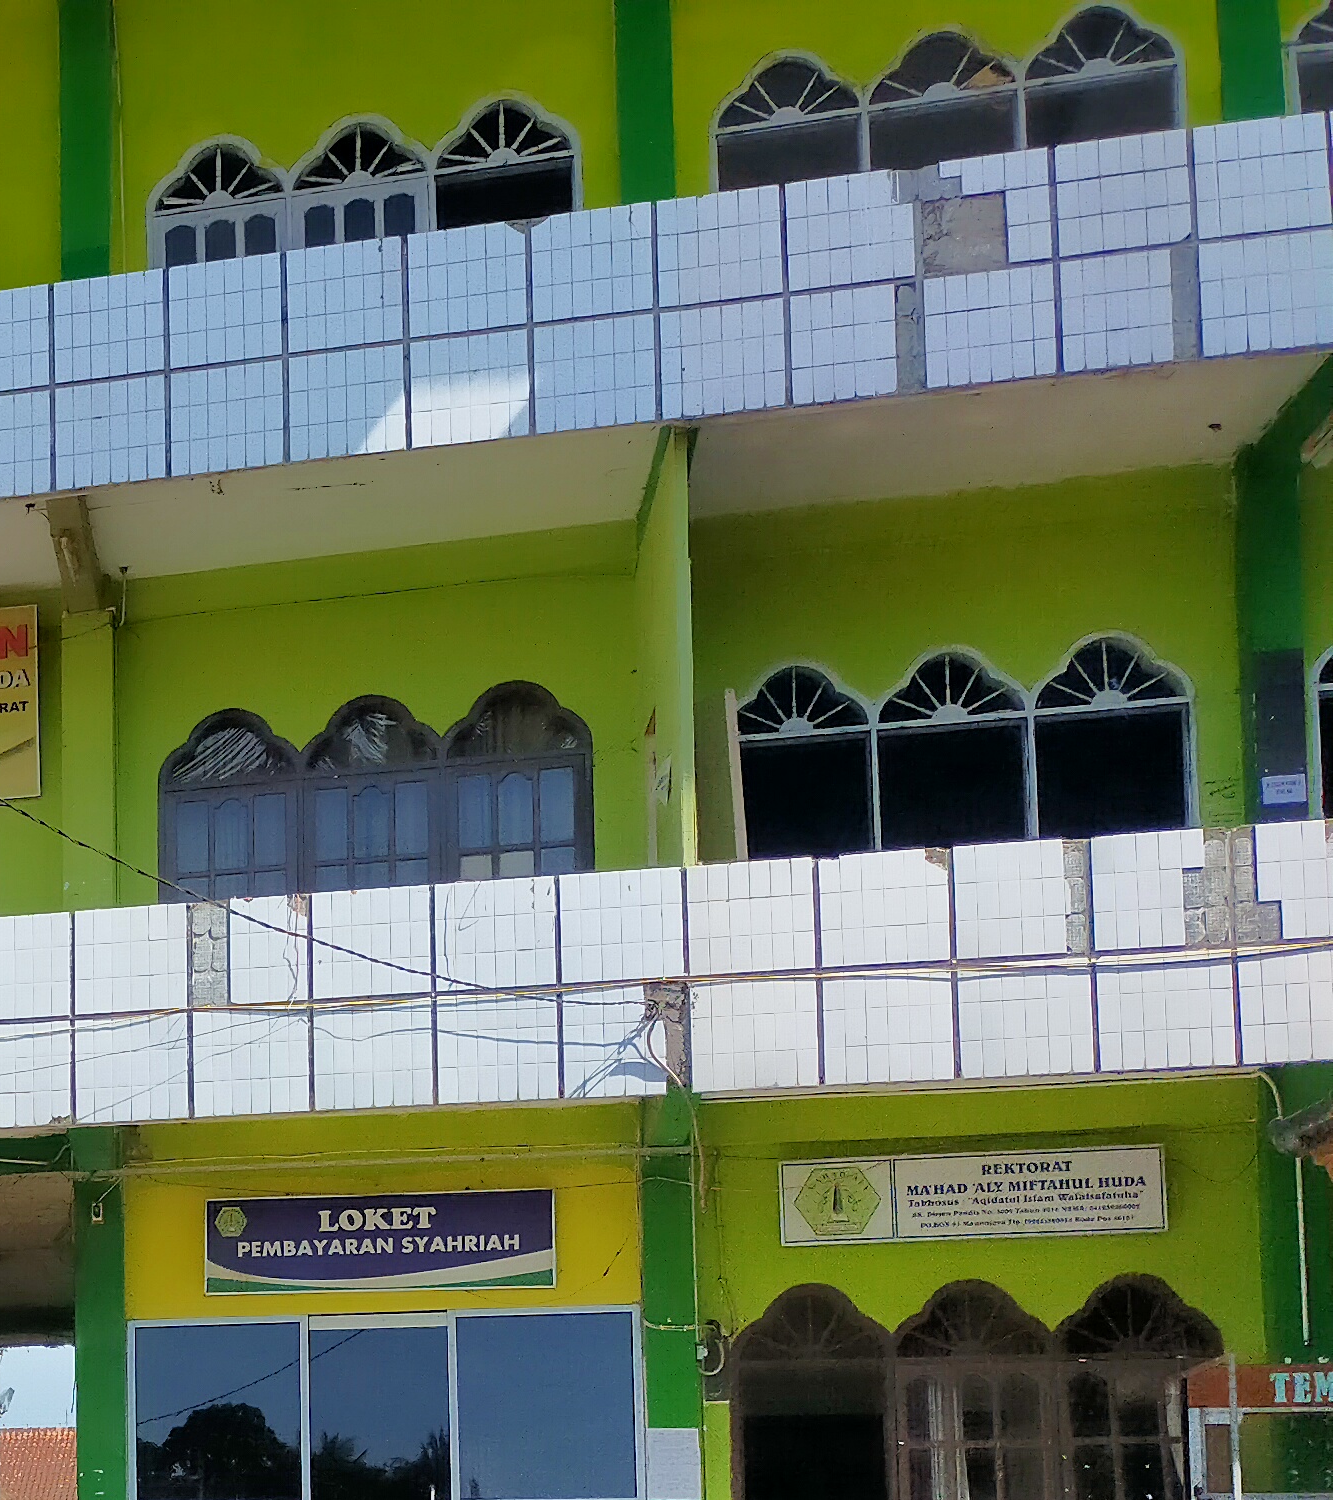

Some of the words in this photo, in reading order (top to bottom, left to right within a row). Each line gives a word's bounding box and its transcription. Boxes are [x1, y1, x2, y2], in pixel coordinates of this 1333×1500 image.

[981, 1160, 1072, 1176] REKTORAT
[1008, 1178, 1094, 1192] MIFTAHUL
[1098, 1175, 1147, 1188] HUDA
[318, 1206, 437, 1233] LOKET
[236, 1237, 394, 1258] PEMBAYARAN
[401, 1234, 520, 1253] SYAHRIAH
[1269, 1372, 1333, 1403] TEM
